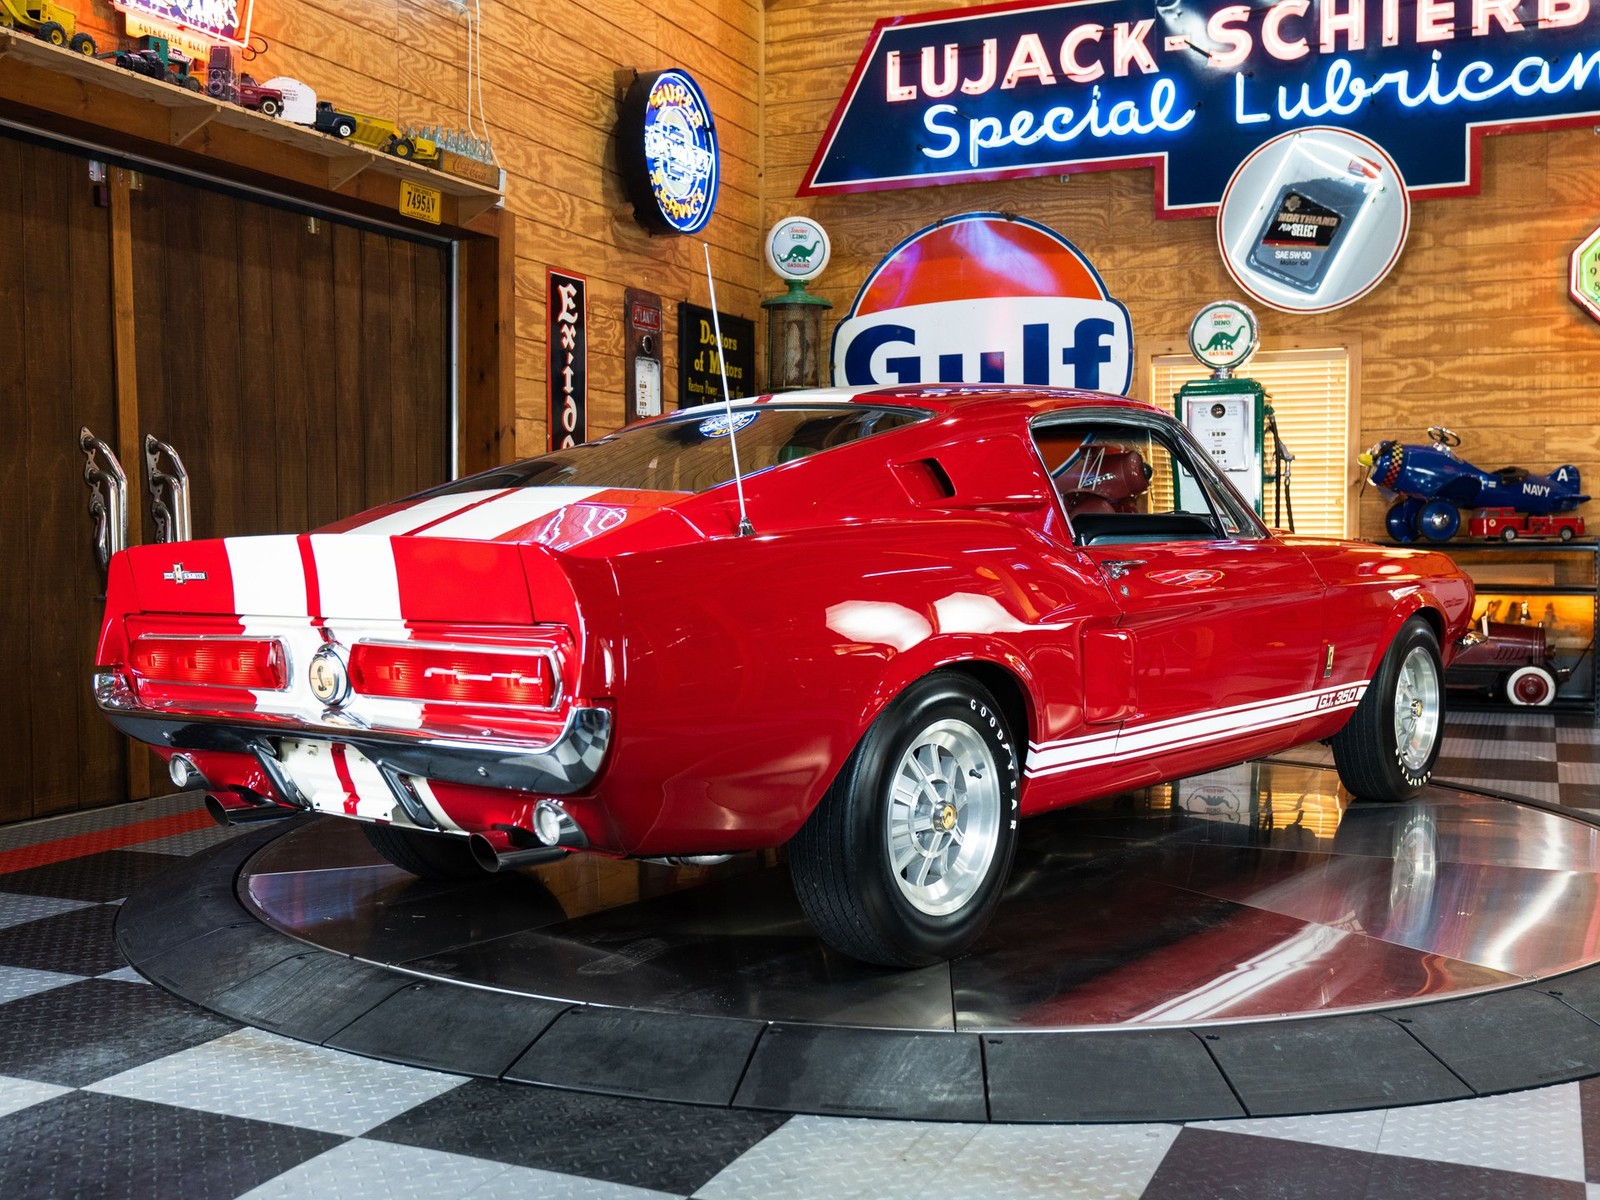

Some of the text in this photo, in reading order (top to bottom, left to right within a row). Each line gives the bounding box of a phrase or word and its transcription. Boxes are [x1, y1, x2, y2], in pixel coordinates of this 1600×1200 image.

[921, 78, 1197, 167] Special
[407, 191, 436, 215] 7495AV
[1278, 212, 1338, 227] NORTHLAND
[1290, 223, 1319, 238] SELECT
[1275, 250, 1290, 259] SAE
[1589, 266, 1597, 277] 9
[700, 319, 738, 351] Dotors
[845, 318, 1115, 391] Gulf
[694, 350, 743, 380] of Mtors
[1556, 469, 1569, 483] A
[1522, 483, 1551, 498] NAVY
[1334, 687, 1358, 706] 350
[969, 699, 1018, 830] GOODYEAR
